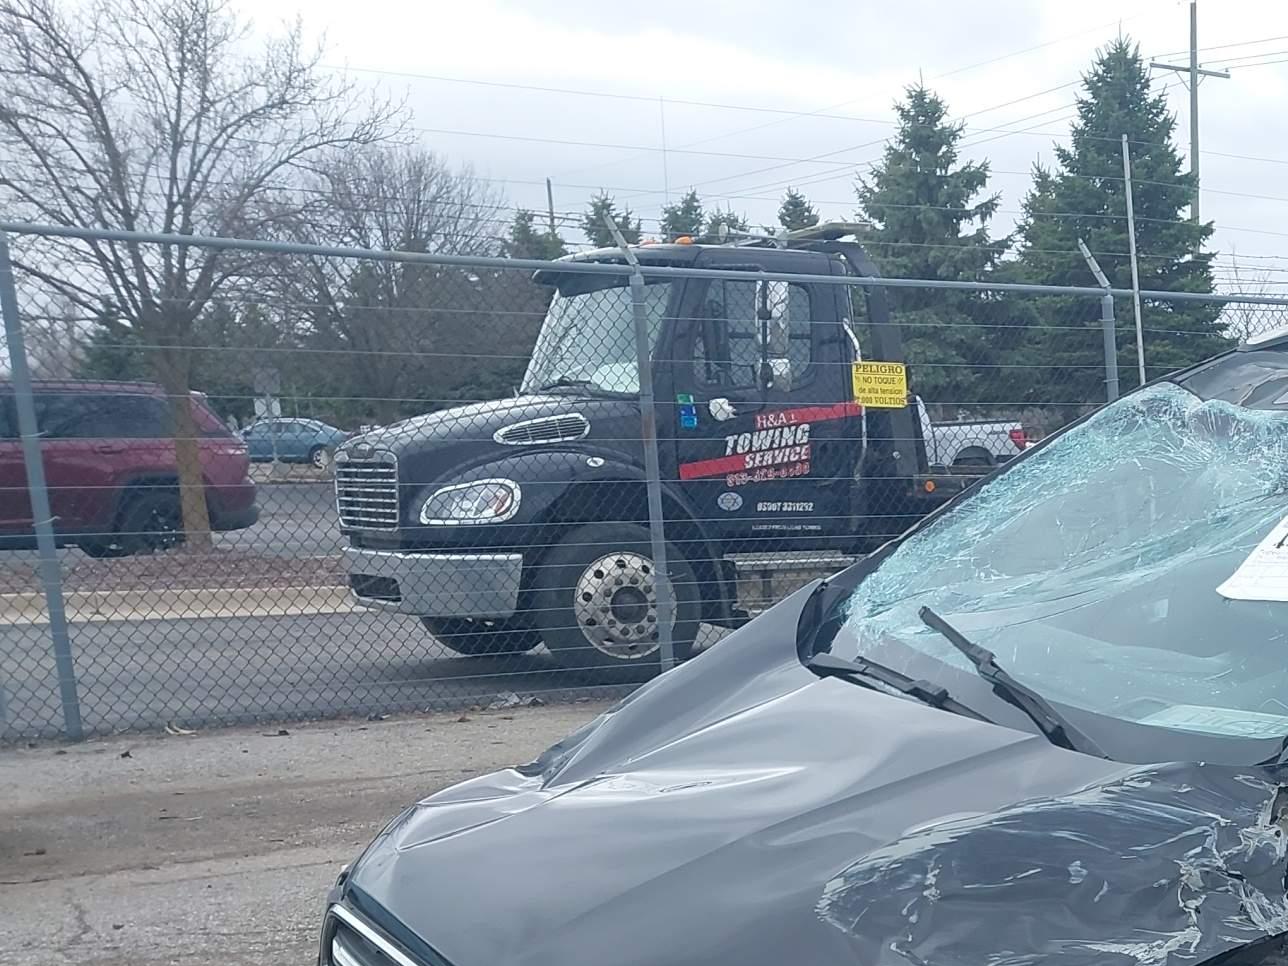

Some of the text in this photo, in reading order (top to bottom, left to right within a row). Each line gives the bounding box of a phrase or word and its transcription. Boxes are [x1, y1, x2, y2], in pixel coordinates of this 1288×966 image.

[855, 364, 903, 374] PELIGRO
[862, 376, 897, 385] NO TOQUE
[875, 396, 905, 405] VOLTIOS
[756, 412, 788, 429] H&A
[725, 423, 810, 456] TOWING
[744, 445, 810, 469] SERVICE
